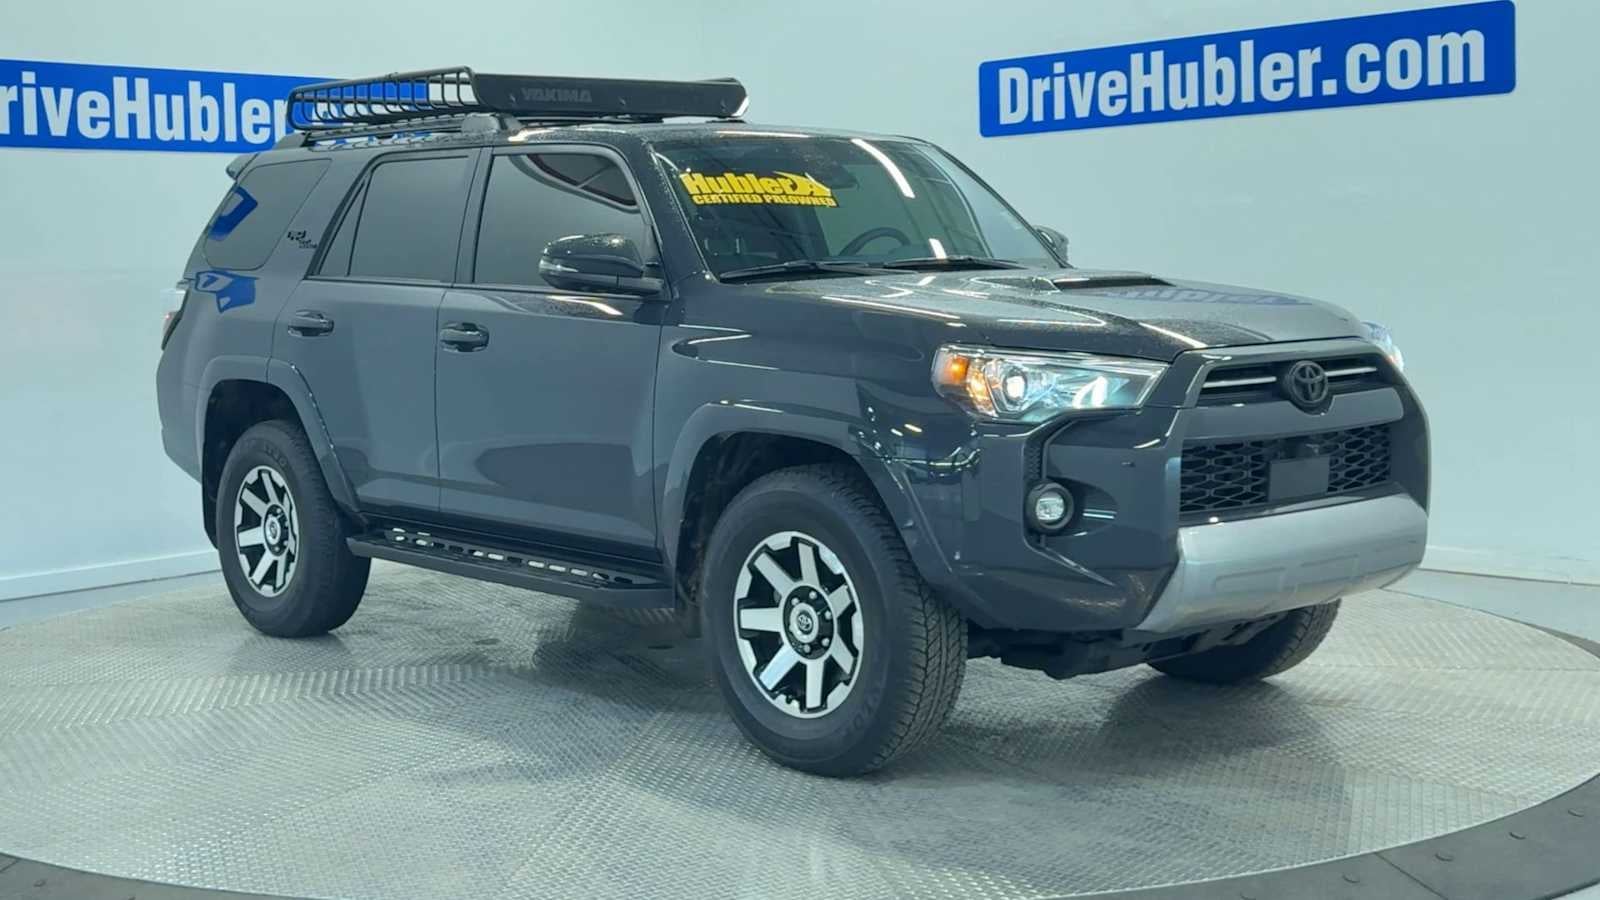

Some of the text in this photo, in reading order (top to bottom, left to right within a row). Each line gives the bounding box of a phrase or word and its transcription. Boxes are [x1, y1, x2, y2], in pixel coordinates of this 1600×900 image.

[998, 29, 1485, 125] DriveHubler.com
[521, 88, 592, 103] YAKIMA
[0, 71, 424, 148] riveHubler
[679, 173, 798, 194] Hubler
[692, 194, 762, 205] CERTIFIED
